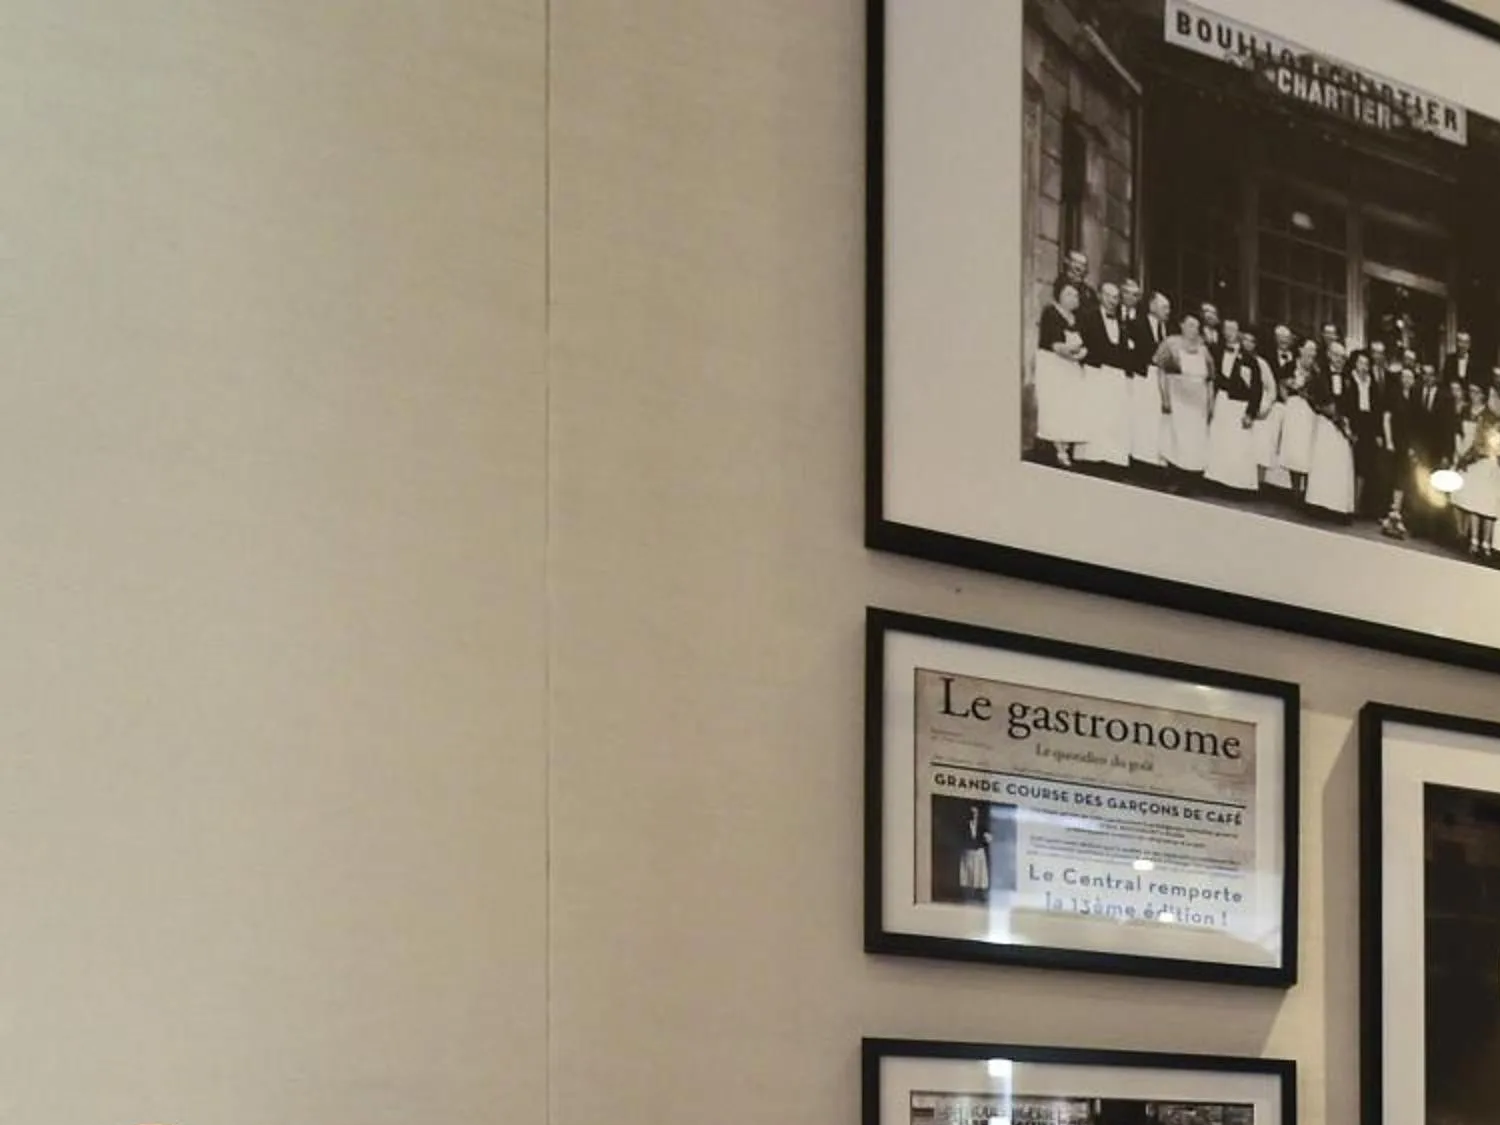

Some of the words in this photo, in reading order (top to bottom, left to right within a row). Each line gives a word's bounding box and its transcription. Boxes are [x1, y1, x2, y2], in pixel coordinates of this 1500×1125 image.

[1176, 10, 1308, 70] BOUILLO
[1277, 66, 1391, 130] CHARTIER
[939, 676, 992, 721] Le
[1007, 701, 1242, 760] gastronome
[934, 772, 1001, 793] GRANDE
[1006, 783, 1069, 803] COURSE
[1074, 791, 1102, 807] DES
[1107, 797, 1180, 817] GARÇONS
[1183, 807, 1201, 820] DE
[1205, 808, 1242, 826] CAFÉ
[1029, 863, 1053, 882] Le
[1063, 867, 1141, 892] Central
[1149, 881, 1243, 903] remporte
[1045, 891, 1063, 912] la
